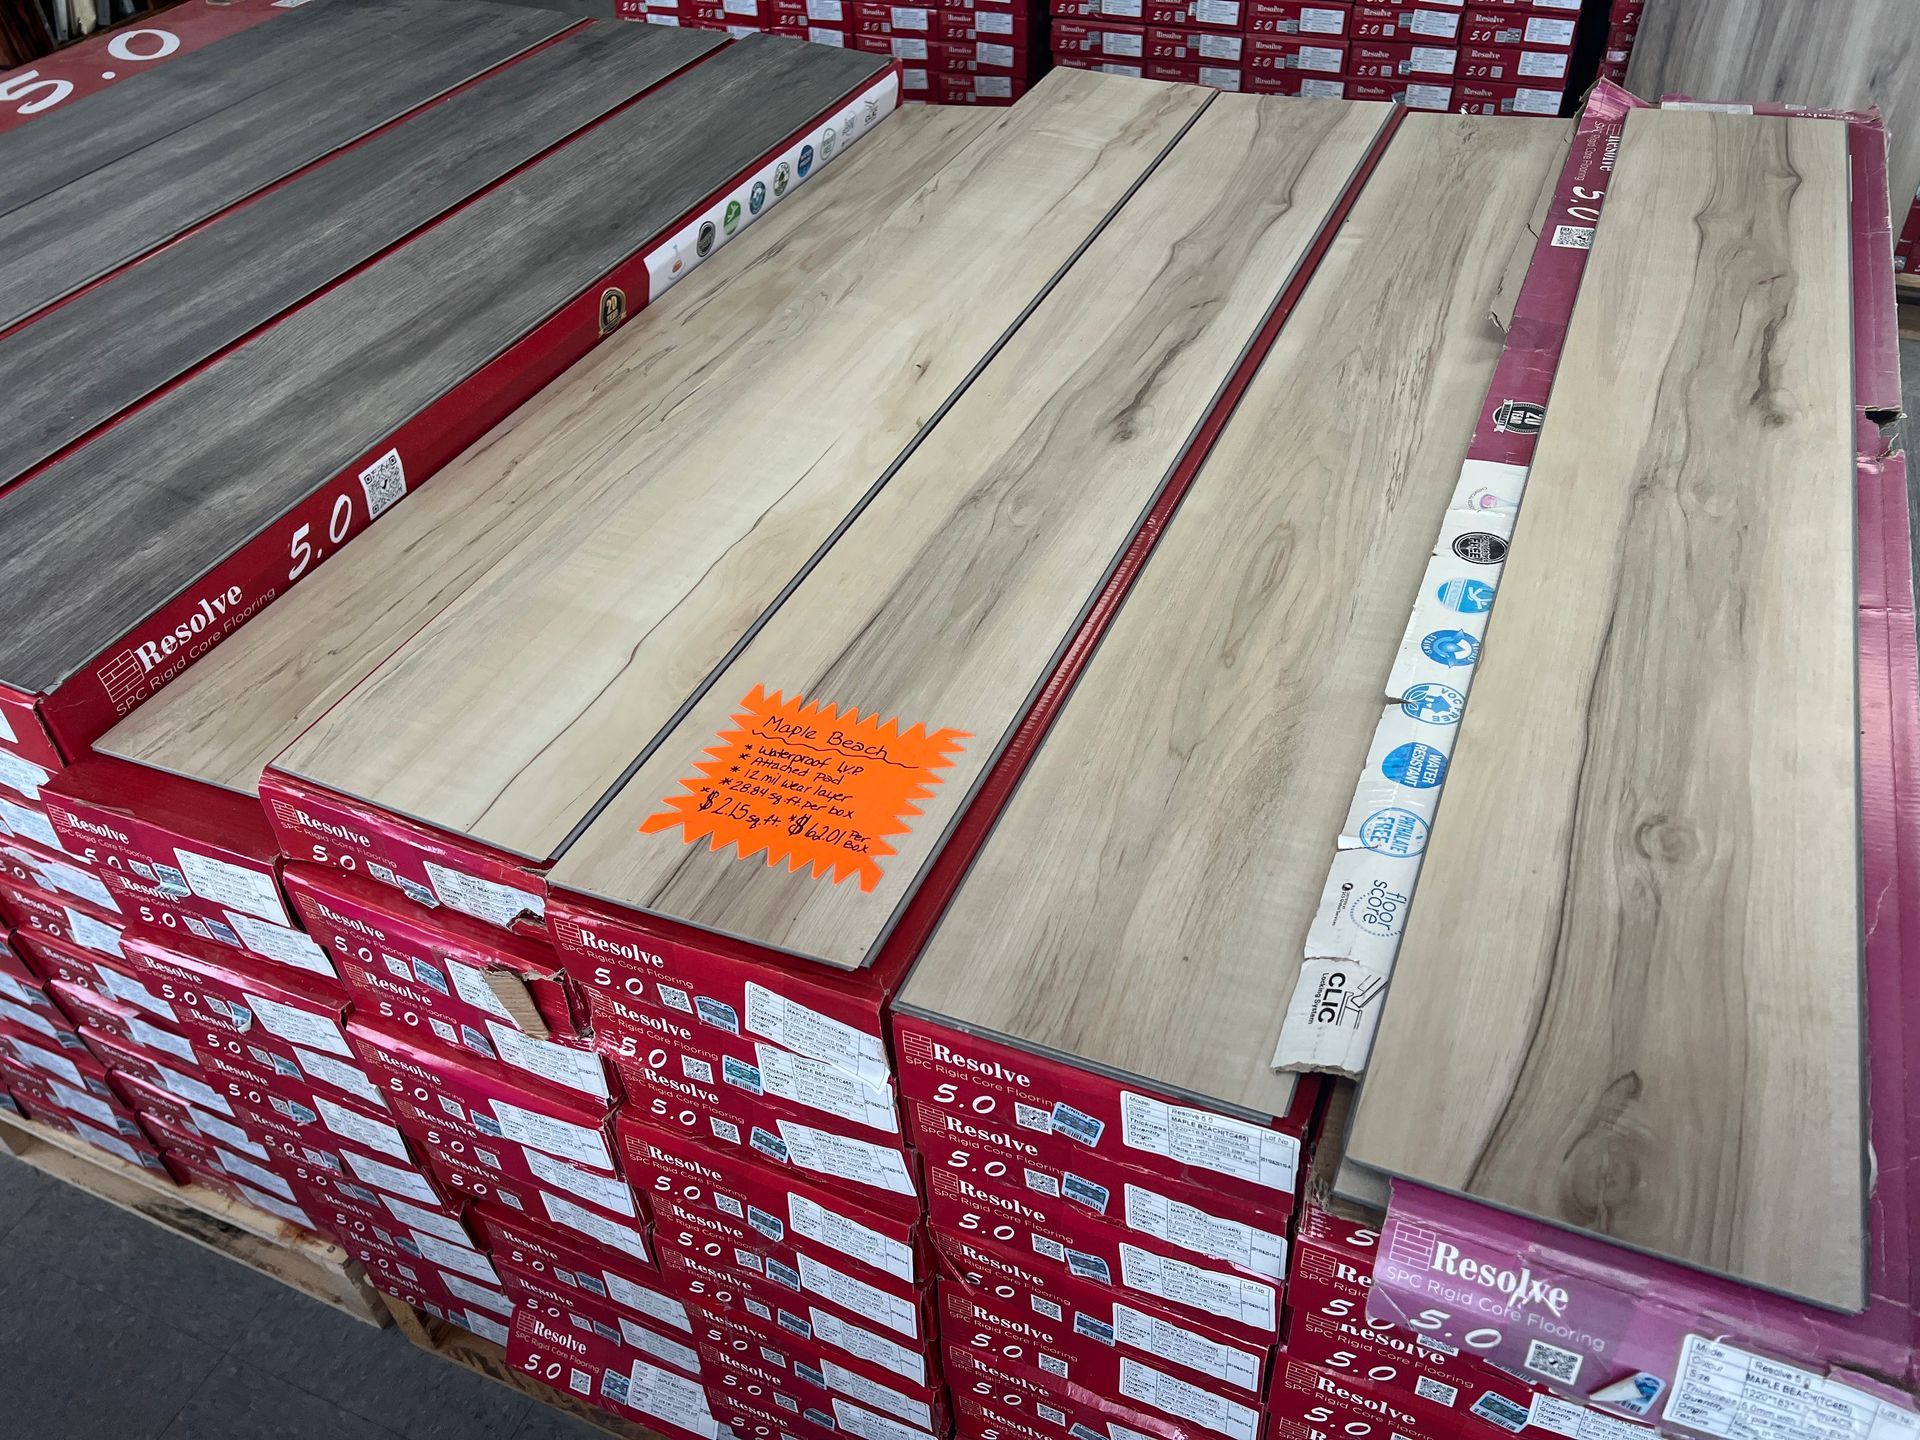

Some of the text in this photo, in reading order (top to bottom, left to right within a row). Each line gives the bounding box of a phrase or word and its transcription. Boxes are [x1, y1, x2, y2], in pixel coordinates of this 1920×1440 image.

[1152, 10, 1172, 22] 5.0
[1253, 20, 1273, 31] 5.0
[1359, 24, 1380, 35] 5.0
[1475, 14, 1505, 24] Resolve
[1153, 45, 1172, 57] 5.0
[1470, 30, 1492, 42] 5.0
[1252, 57, 1272, 68] 5.0
[1471, 49, 1501, 60] Resolve
[0, 28, 181, 116] 5.0
[1356, 65, 1378, 77] 5.0
[1466, 66, 1487, 77] 5.0
[606, 296, 619, 313] 20
[288, 493, 353, 581] 5.0
[1468, 537, 1485, 560] FREE
[133, 583, 243, 674] Resolve
[116, 587, 276, 717] SPC Rigid Core Flooring
[1440, 687, 1464, 706] VOC
[763, 715, 887, 760] Maple Beach
[751, 756, 844, 786] Attached pad
[1404, 743, 1429, 788] RESISTANT
[1423, 753, 1443, 785] WATER
[729, 780, 769, 798] 28.84
[828, 805, 854, 819] box
[744, 769, 853, 802] 12 mil wear layer
[66, 812, 130, 845] Resolve
[296, 808, 372, 847] Resolve
[1369, 815, 1396, 845] FREE
[312, 844, 356, 871] 5.0
[139, 906, 177, 928] 5.0
[1362, 879, 1388, 926] score
[1376, 891, 1408, 932] floor
[317, 902, 386, 942] Resolve
[334, 935, 373, 963] 5.0
[581, 929, 664, 968] Resolve
[143, 955, 204, 985] Resolve
[561, 943, 694, 990] SPC Rigid Core Flooring
[595, 968, 644, 995] 5.0
[161, 984, 198, 1006] 5.0
[365, 972, 433, 1006] Resolve
[1307, 972, 1330, 1025] Locking System
[1317, 972, 1346, 1024] CLIC
[379, 1001, 420, 1027] 5.0
[613, 1001, 692, 1040] Resolve
[207, 1033, 242, 1055] 5.0
[618, 1036, 668, 1068] 5.0
[214, 1058, 269, 1087] Resolve
[378, 1050, 442, 1086] Resolve
[906, 1055, 1004, 1092] SPC Rigid Core
[932, 1043, 1031, 1088] Resolve
[228, 1083, 261, 1105] 5.0
[390, 1077, 430, 1101] 5.0
[644, 1068, 720, 1104] Resolve
[933, 1083, 997, 1114] 5.0
[250, 1112, 302, 1139] Resolve
[414, 1106, 478, 1139] Resolve
[651, 1098, 697, 1127] 5.0
[1130, 1117, 1167, 1132] Thickness
[1171, 1116, 1196, 1128] MAPLE
[428, 1131, 466, 1154] 5.0
[920, 1125, 1013, 1159] SPC Rigid Core
[945, 1114, 1039, 1157] Resolve
[1130, 1132, 1153, 1143] Origin
[439, 1148, 500, 1182] Resolve
[649, 1145, 723, 1182] Resolve
[947, 1150, 1007, 1177] 5.0
[451, 1173, 488, 1195] 5.0
[655, 1175, 701, 1200] 5.0
[934, 1187, 1074, 1245] SPC Rigid Core Flooring
[959, 1179, 1046, 1223] Resolve
[336, 1213, 366, 1233] 5.0
[672, 1204, 745, 1240] Resolve
[958, 1213, 1015, 1241] 5.0
[502, 1230, 560, 1262] Resolve
[678, 1231, 722, 1257] 5.0
[360, 1250, 390, 1270] 5.0
[512, 1251, 546, 1273] 5.0
[683, 1256, 753, 1290] Resolve
[962, 1243, 1045, 1285] Resolve
[965, 1271, 1015, 1298] 5.0
[1431, 1240, 1570, 1312] Resolve
[689, 1280, 732, 1303] 5.0
[972, 1304, 1054, 1343] Resolve
[1386, 1266, 1607, 1353] SPC Rigid Core Flooring
[533, 1320, 587, 1360] Resolve
[708, 1328, 749, 1352] 5.0
[1409, 1309, 1503, 1349] 5.0
[970, 1332, 1022, 1359] 5.0
[524, 1352, 563, 1380] 5.0
[719, 1352, 782, 1386] Resolve
[1325, 1351, 1397, 1381] 5.0
[1337, 1335, 1475, 1390] Rigid Flooring
[723, 1375, 763, 1397] 5.0
[973, 1358, 1050, 1398] Resolve
[1745, 1373, 1781, 1392] MAPLE
[972, 1382, 1023, 1406] 5.0
[1315, 1391, 1349, 1410] Rigid
[1316, 1376, 1417, 1425] Resolve
[1678, 1401, 1709, 1417] Origin
[1682, 1392, 1725, 1412] Quantity
[727, 1396, 788, 1427] Resolve
[731, 1416, 770, 1436] 5.0
[1304, 1407, 1372, 1436] 5.0
